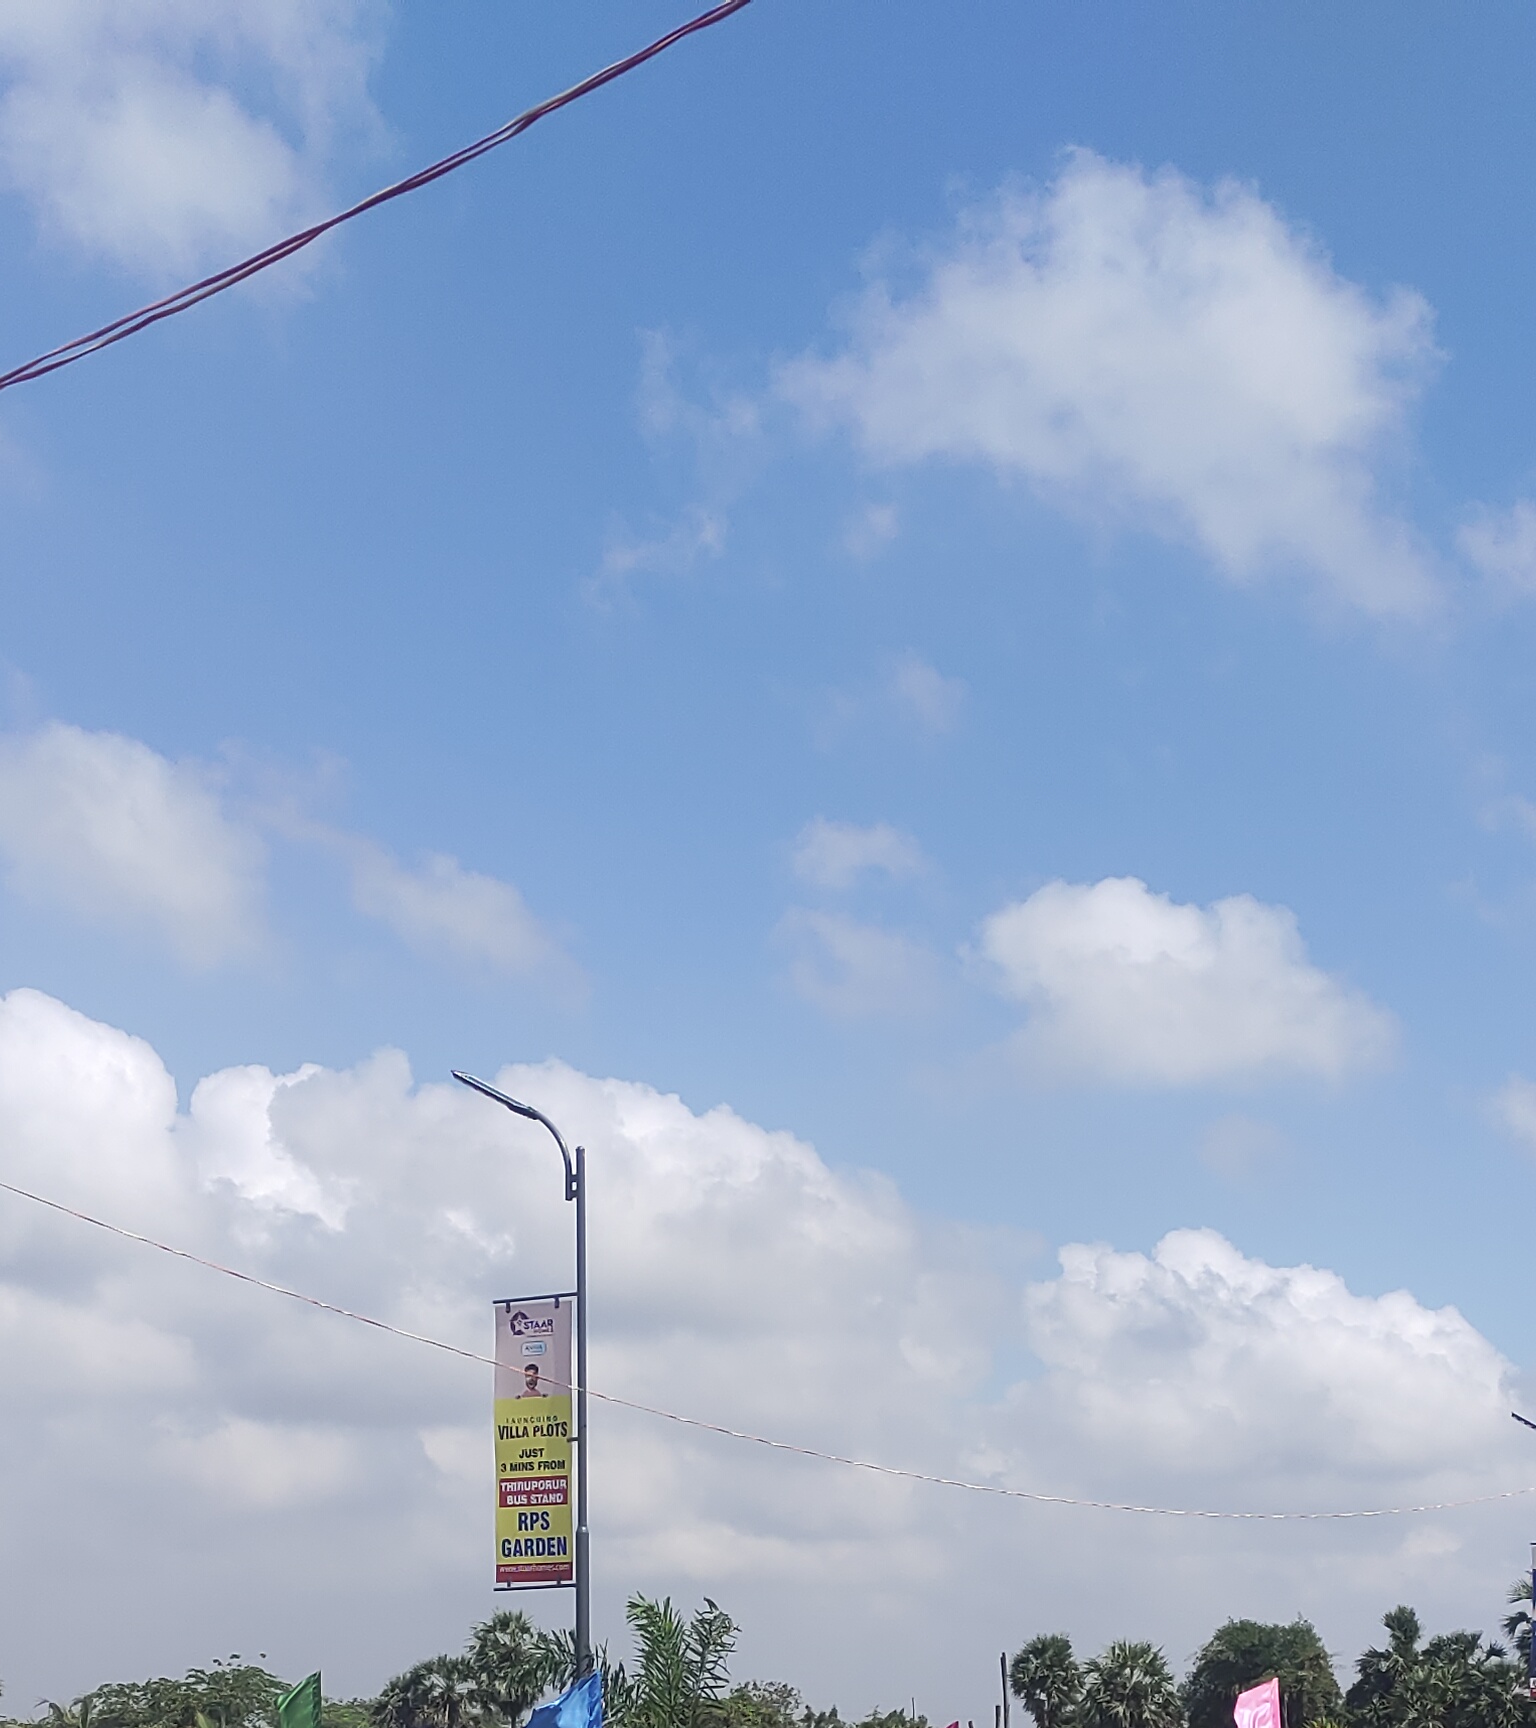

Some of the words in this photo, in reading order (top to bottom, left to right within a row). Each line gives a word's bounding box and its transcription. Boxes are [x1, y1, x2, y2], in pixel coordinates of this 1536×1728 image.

[523, 1318, 554, 1330] STAAR
[498, 1423, 530, 1440] VILLA
[532, 1421, 568, 1438] PLOTS
[518, 1447, 545, 1459] JUST
[500, 1463, 507, 1473] 3
[509, 1461, 535, 1472] MINS
[537, 1460, 566, 1471] FROM
[506, 1494, 528, 1505] BUS
[530, 1493, 564, 1504] STAND
[517, 1511, 550, 1532] RPS
[501, 1536, 568, 1559] GARDEN
